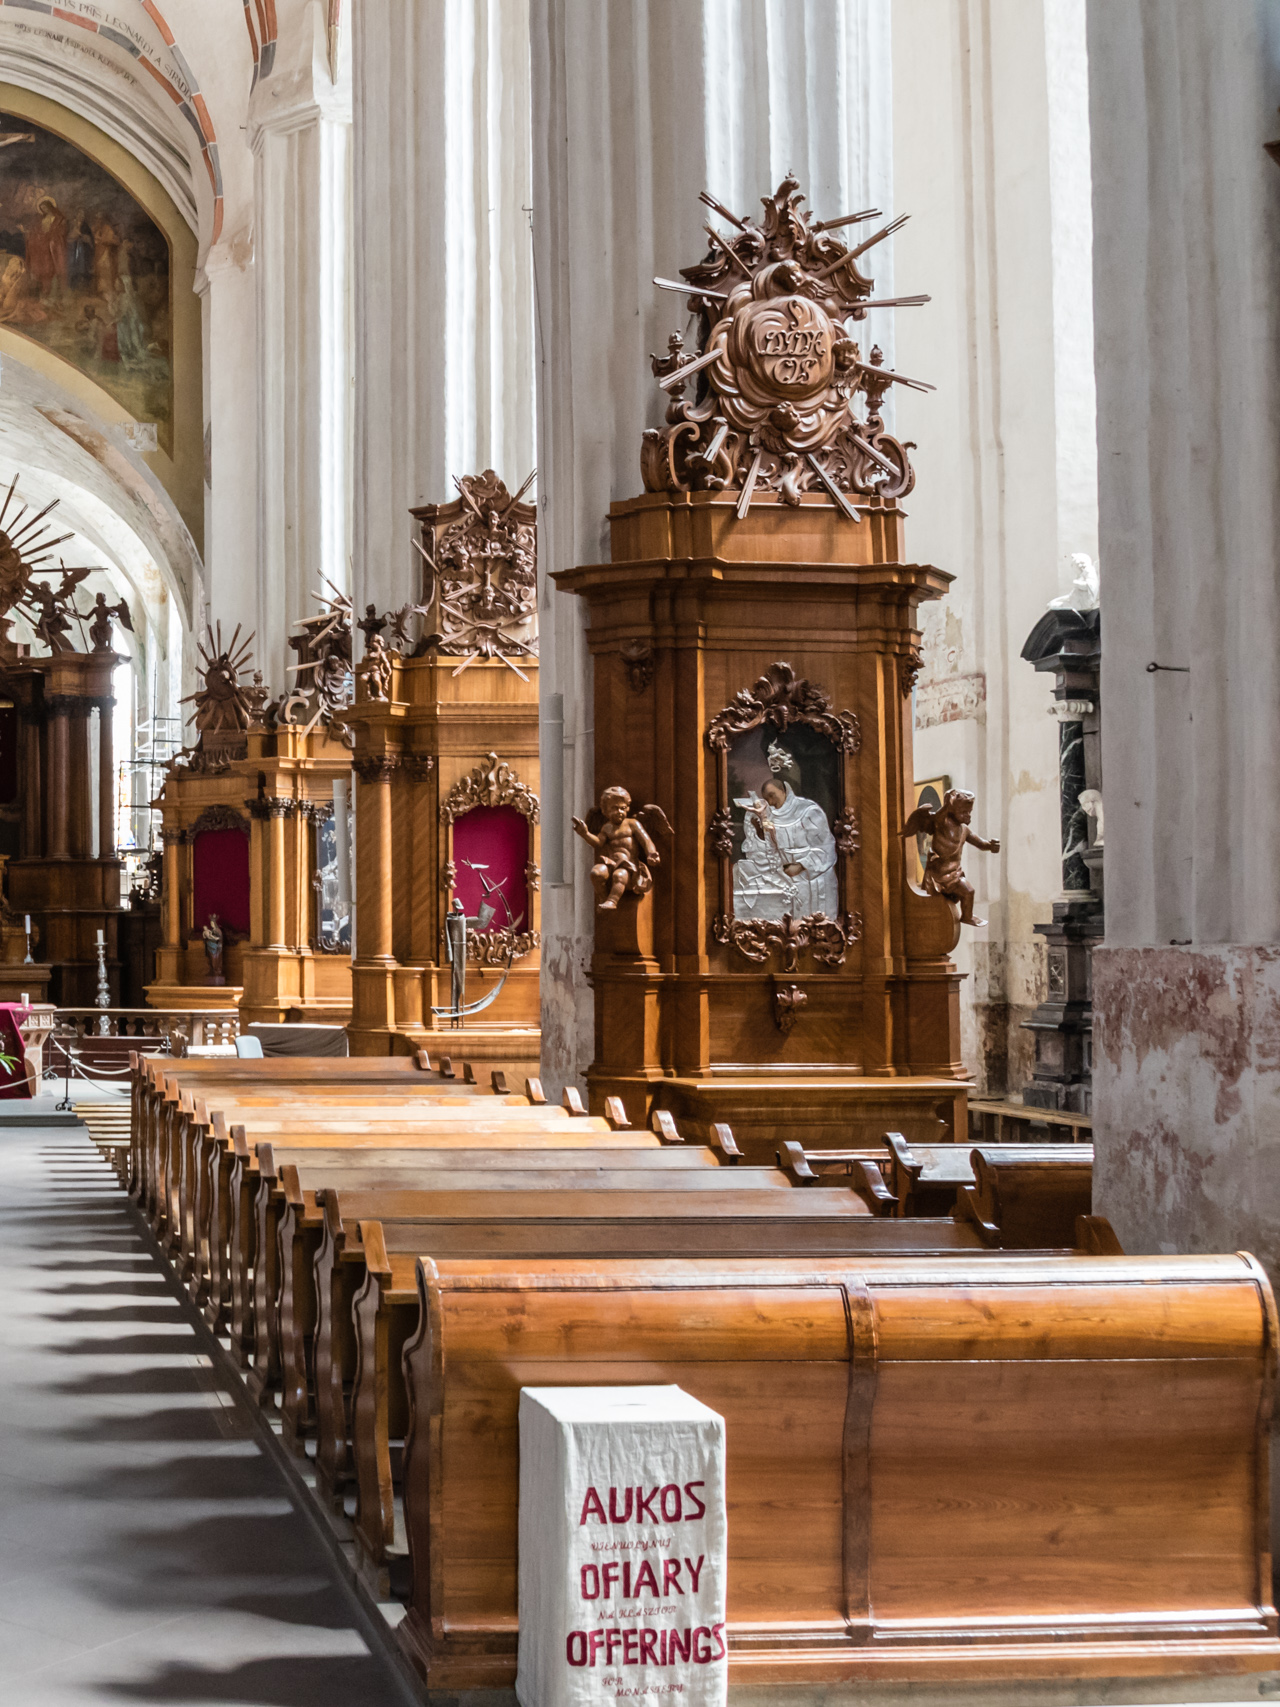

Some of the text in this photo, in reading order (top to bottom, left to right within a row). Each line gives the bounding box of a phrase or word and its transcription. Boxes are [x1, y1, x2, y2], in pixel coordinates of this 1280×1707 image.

[105, 13, 154, 56] LEONARDI
[579, 1480, 706, 1526] AUKOS
[591, 1537, 672, 1551] VIENUOLYNUI
[580, 1554, 705, 1600] OFIARY
[597, 1604, 678, 1621] NA KLASZTOR
[566, 1622, 726, 1667] OFFERINGS
[602, 1676, 624, 1687] FOR
[615, 1682, 684, 1698] MONASTERY
